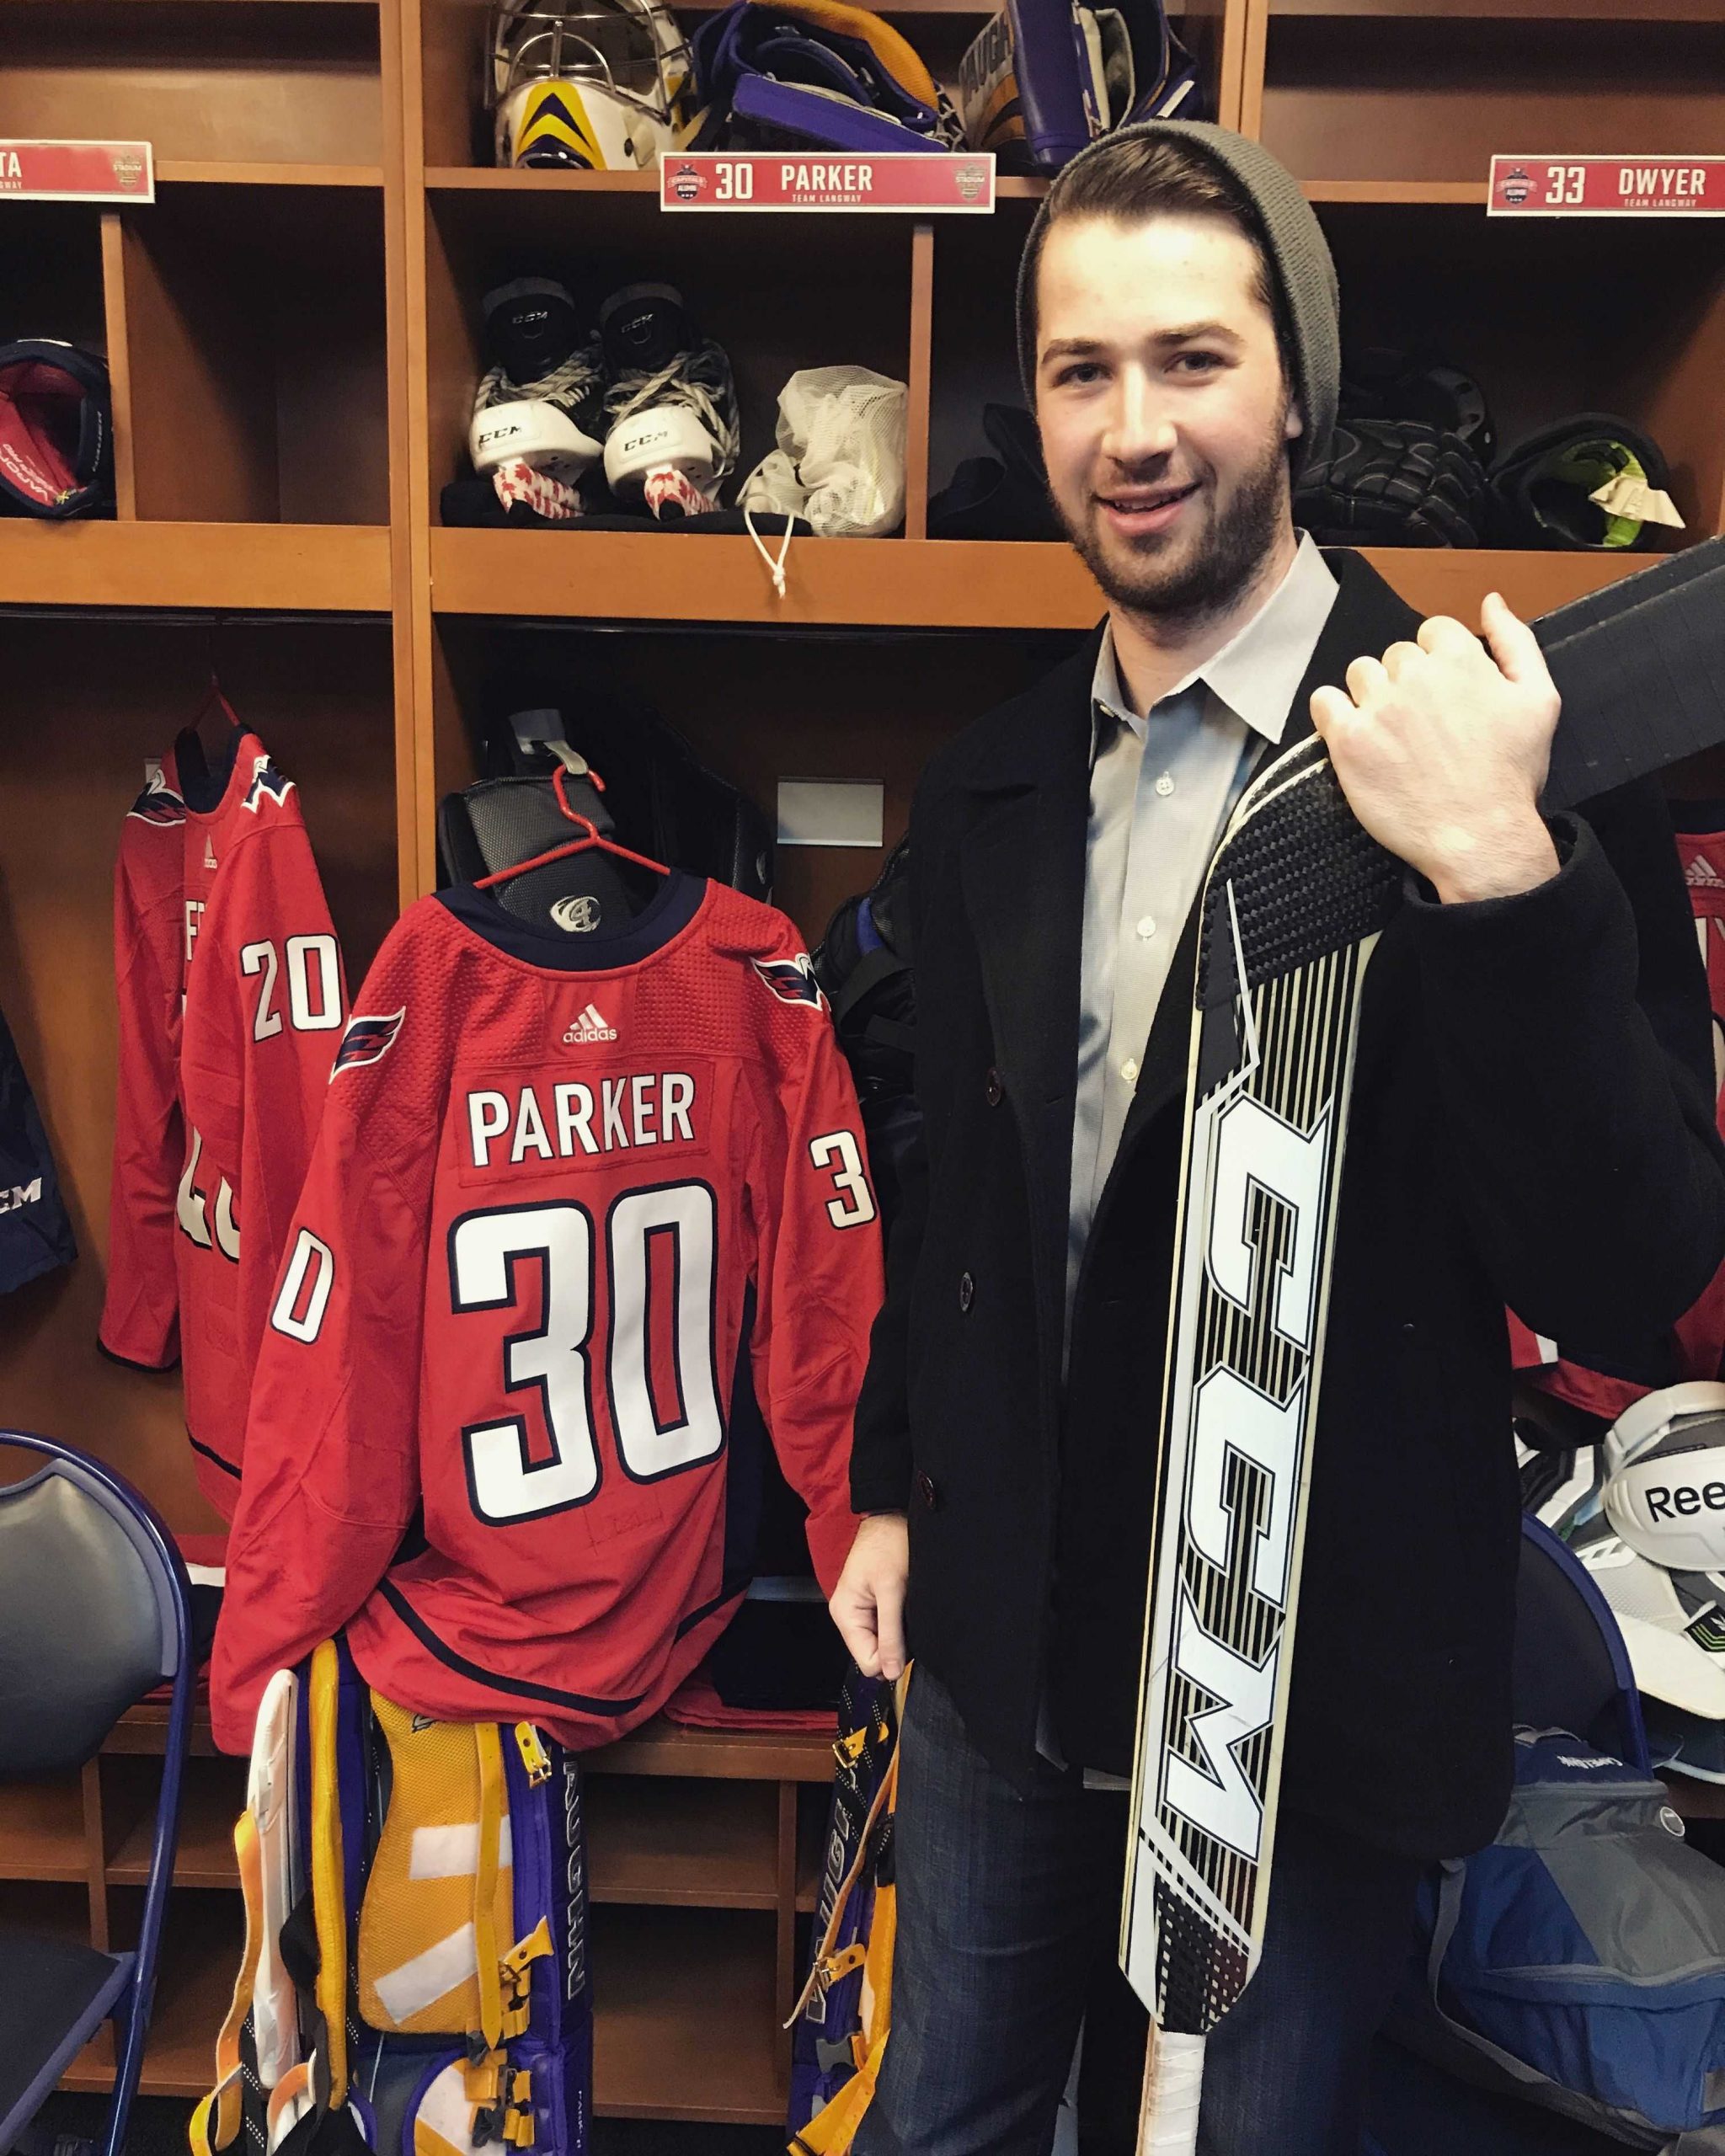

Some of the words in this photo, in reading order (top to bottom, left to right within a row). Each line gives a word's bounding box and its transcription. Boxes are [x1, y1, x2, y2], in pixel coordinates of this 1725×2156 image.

[715, 163, 754, 200] 30
[781, 164, 873, 191] PARKER
[792, 194, 816, 203] TEAM
[820, 194, 862, 203] LANGWAY
[1545, 166, 1586, 204] 33
[1618, 168, 1706, 195] DWYER
[1624, 198, 1650, 207] TEAM
[1653, 198, 1697, 207] LANGWAY
[512, 311, 548, 324] CCM
[239, 932, 344, 1044] 20
[563, 1027, 618, 1043] adidas
[466, 1071, 697, 1168] PARKER
[809, 1129, 877, 1231] 3
[448, 1177, 728, 1528] 30
[1162, 1088, 1332, 1864] CCM
[1644, 1481, 1725, 1524] Ree
[563, 1748, 586, 2001] AUGHN
